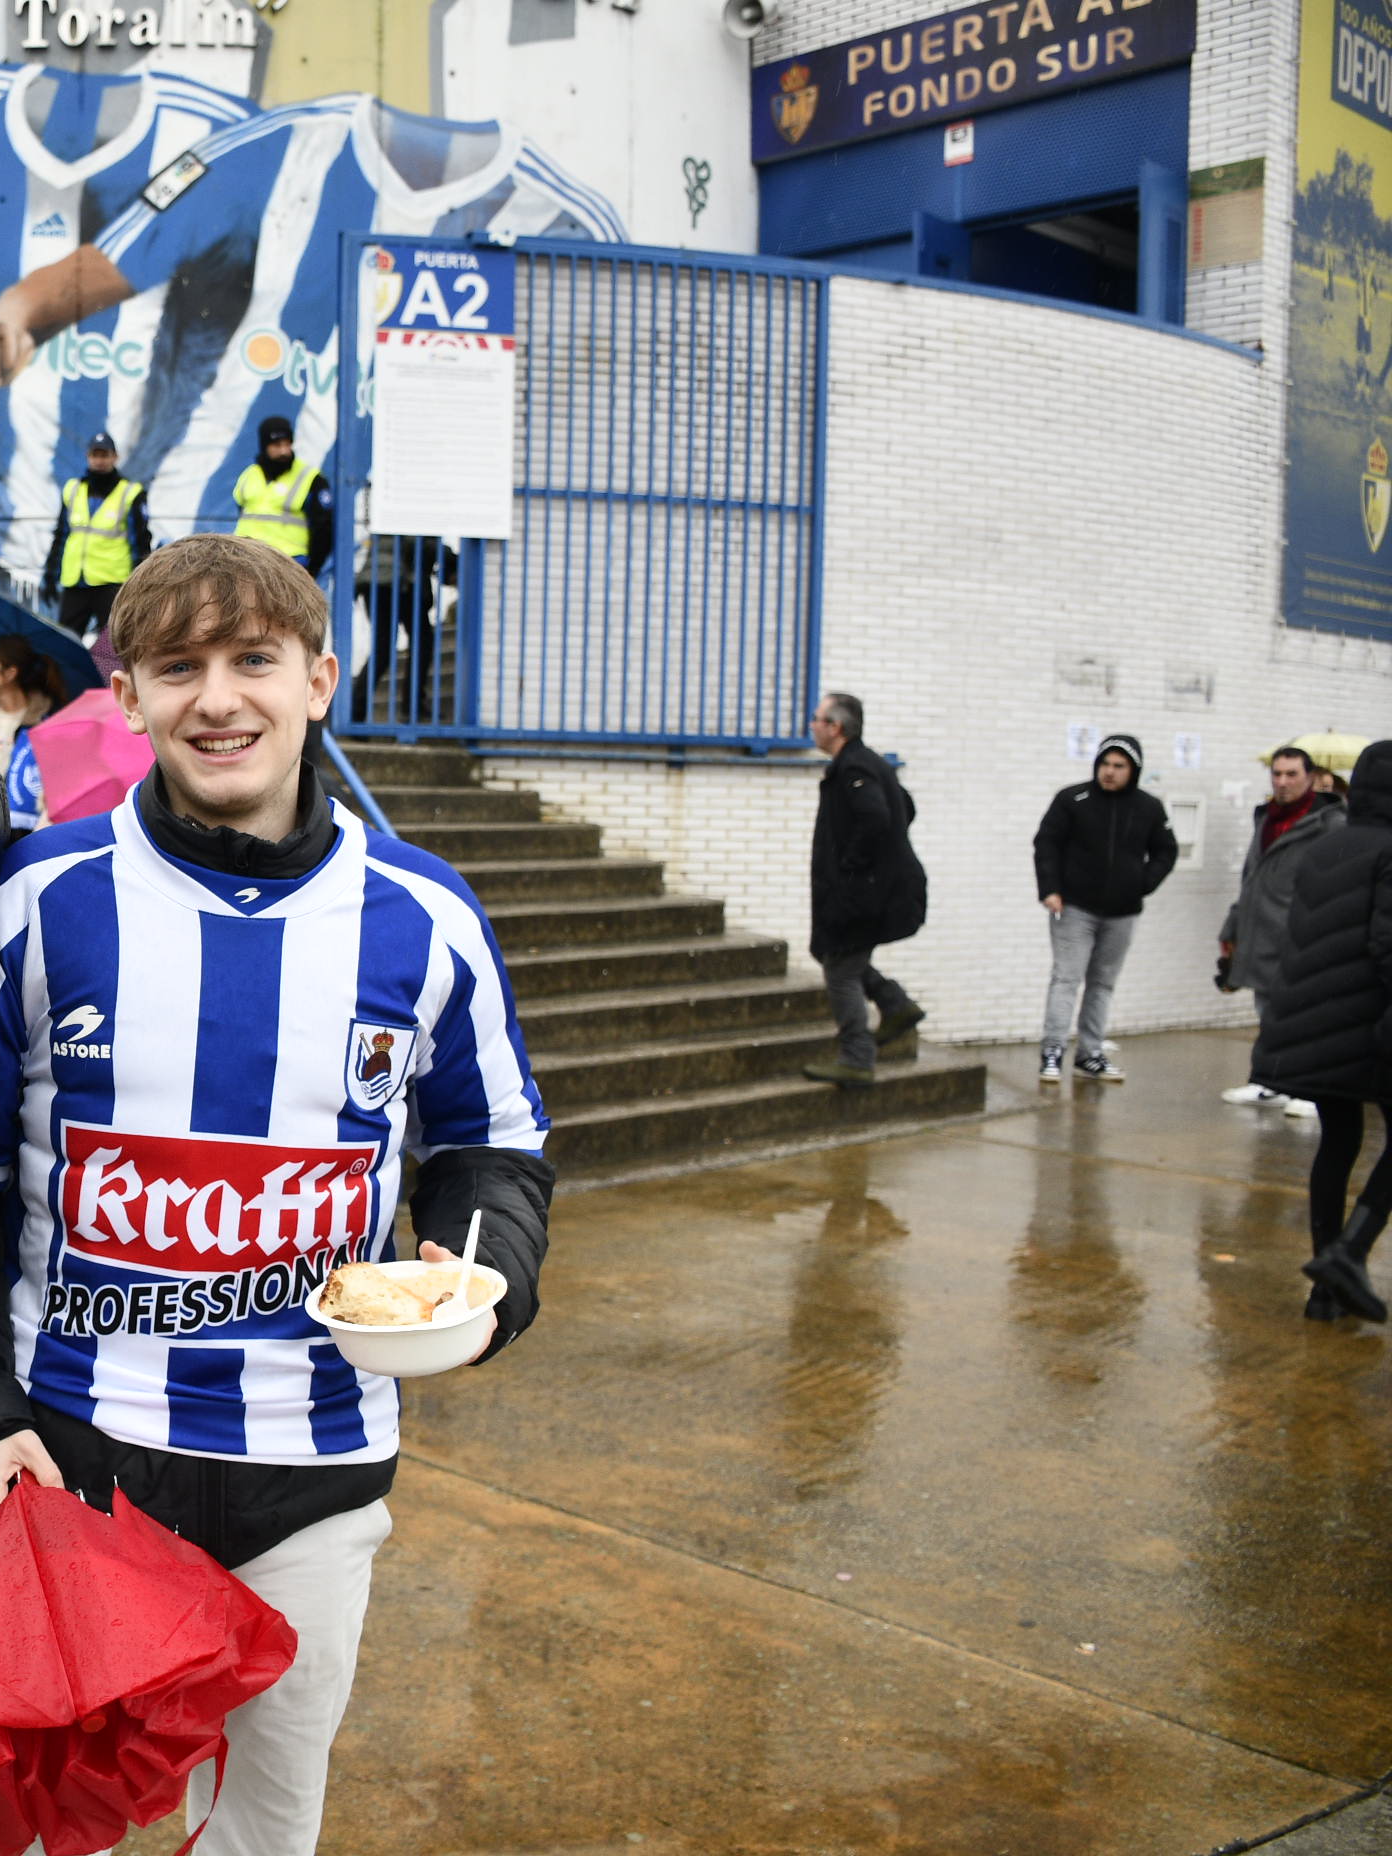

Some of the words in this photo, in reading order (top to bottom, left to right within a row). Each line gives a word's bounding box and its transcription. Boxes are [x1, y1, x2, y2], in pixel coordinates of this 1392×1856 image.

[847, 0, 1055, 86] PUERTA
[1077, 0, 1153, 23] A
[863, 57, 1017, 126] FONDO
[1036, 27, 1135, 82] SUR
[1337, 26, 1392, 117] DEPO
[414, 251, 480, 270] PUERTA
[399, 270, 489, 329] A2
[52, 1042, 111, 1059] ASTORE
